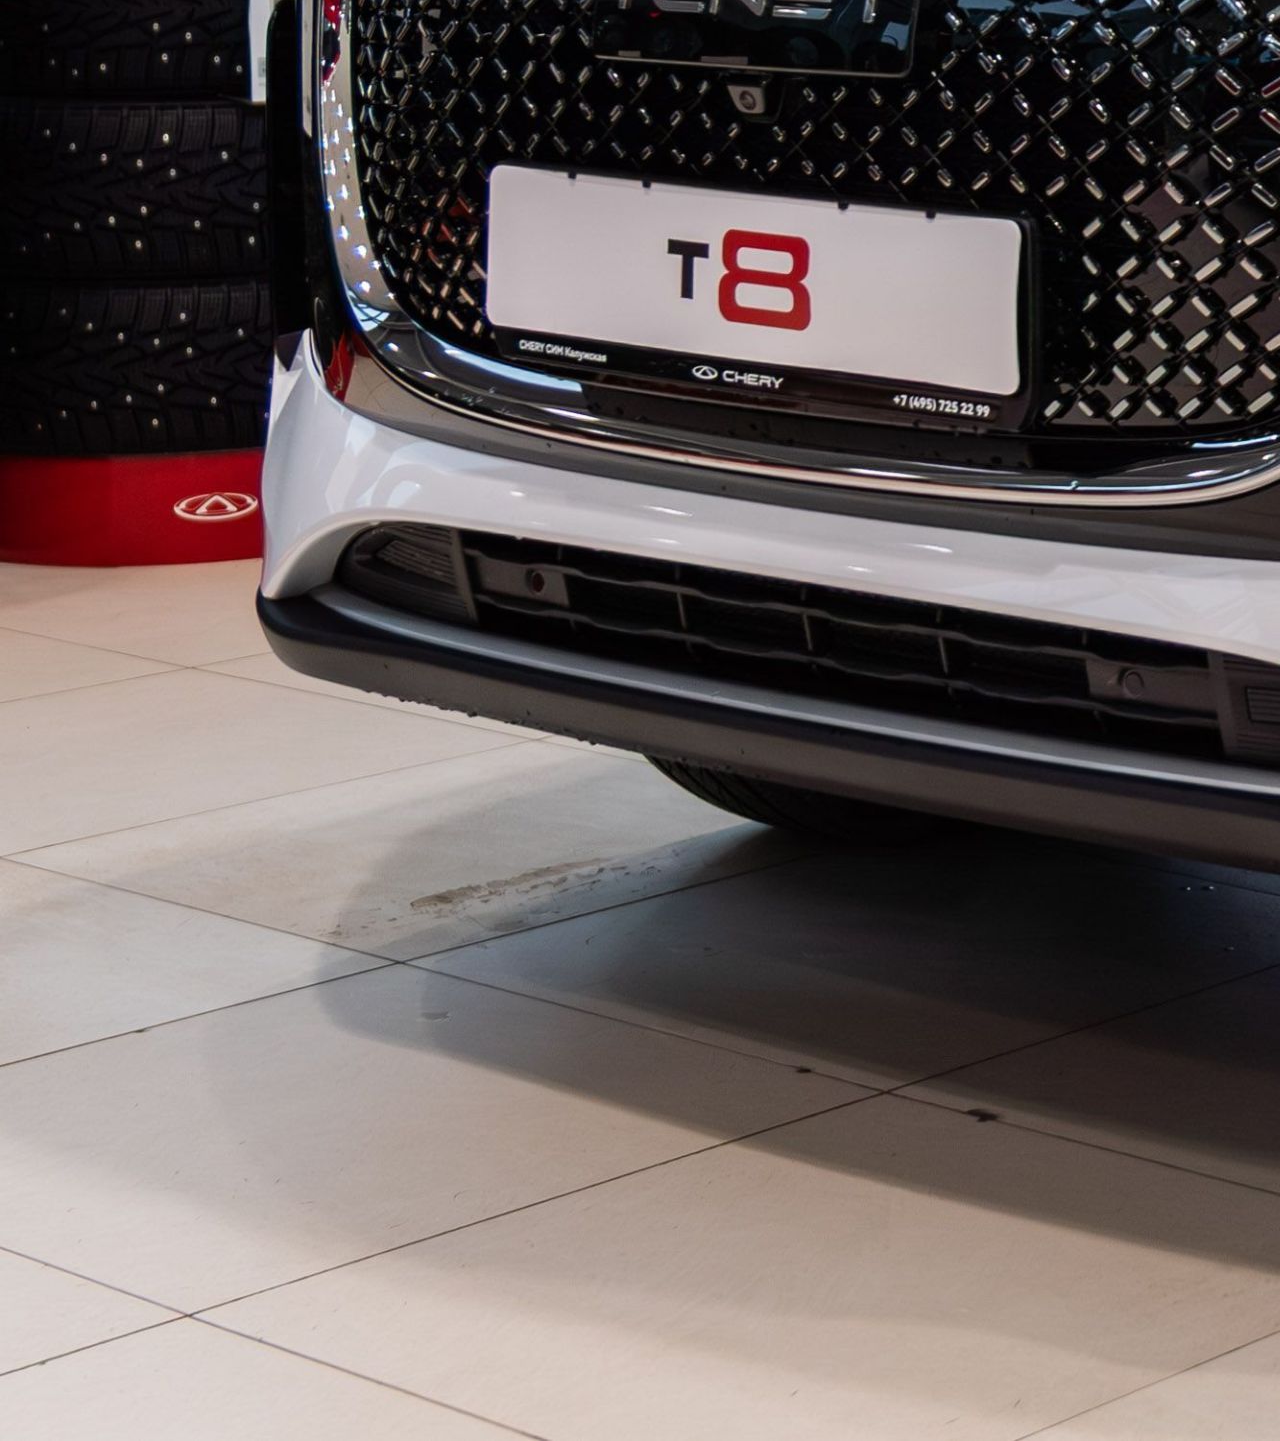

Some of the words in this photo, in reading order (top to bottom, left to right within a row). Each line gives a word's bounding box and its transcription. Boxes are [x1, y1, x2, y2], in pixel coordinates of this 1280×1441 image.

[667, 228, 811, 332] T8
[519, 339, 546, 353] CHERY
[722, 370, 784, 389] CHERY
[893, 394, 908, 407] +7
[908, 395, 937, 412] (495)
[938, 399, 959, 413] 725
[960, 402, 975, 416] 22
[975, 404, 990, 418] 99
